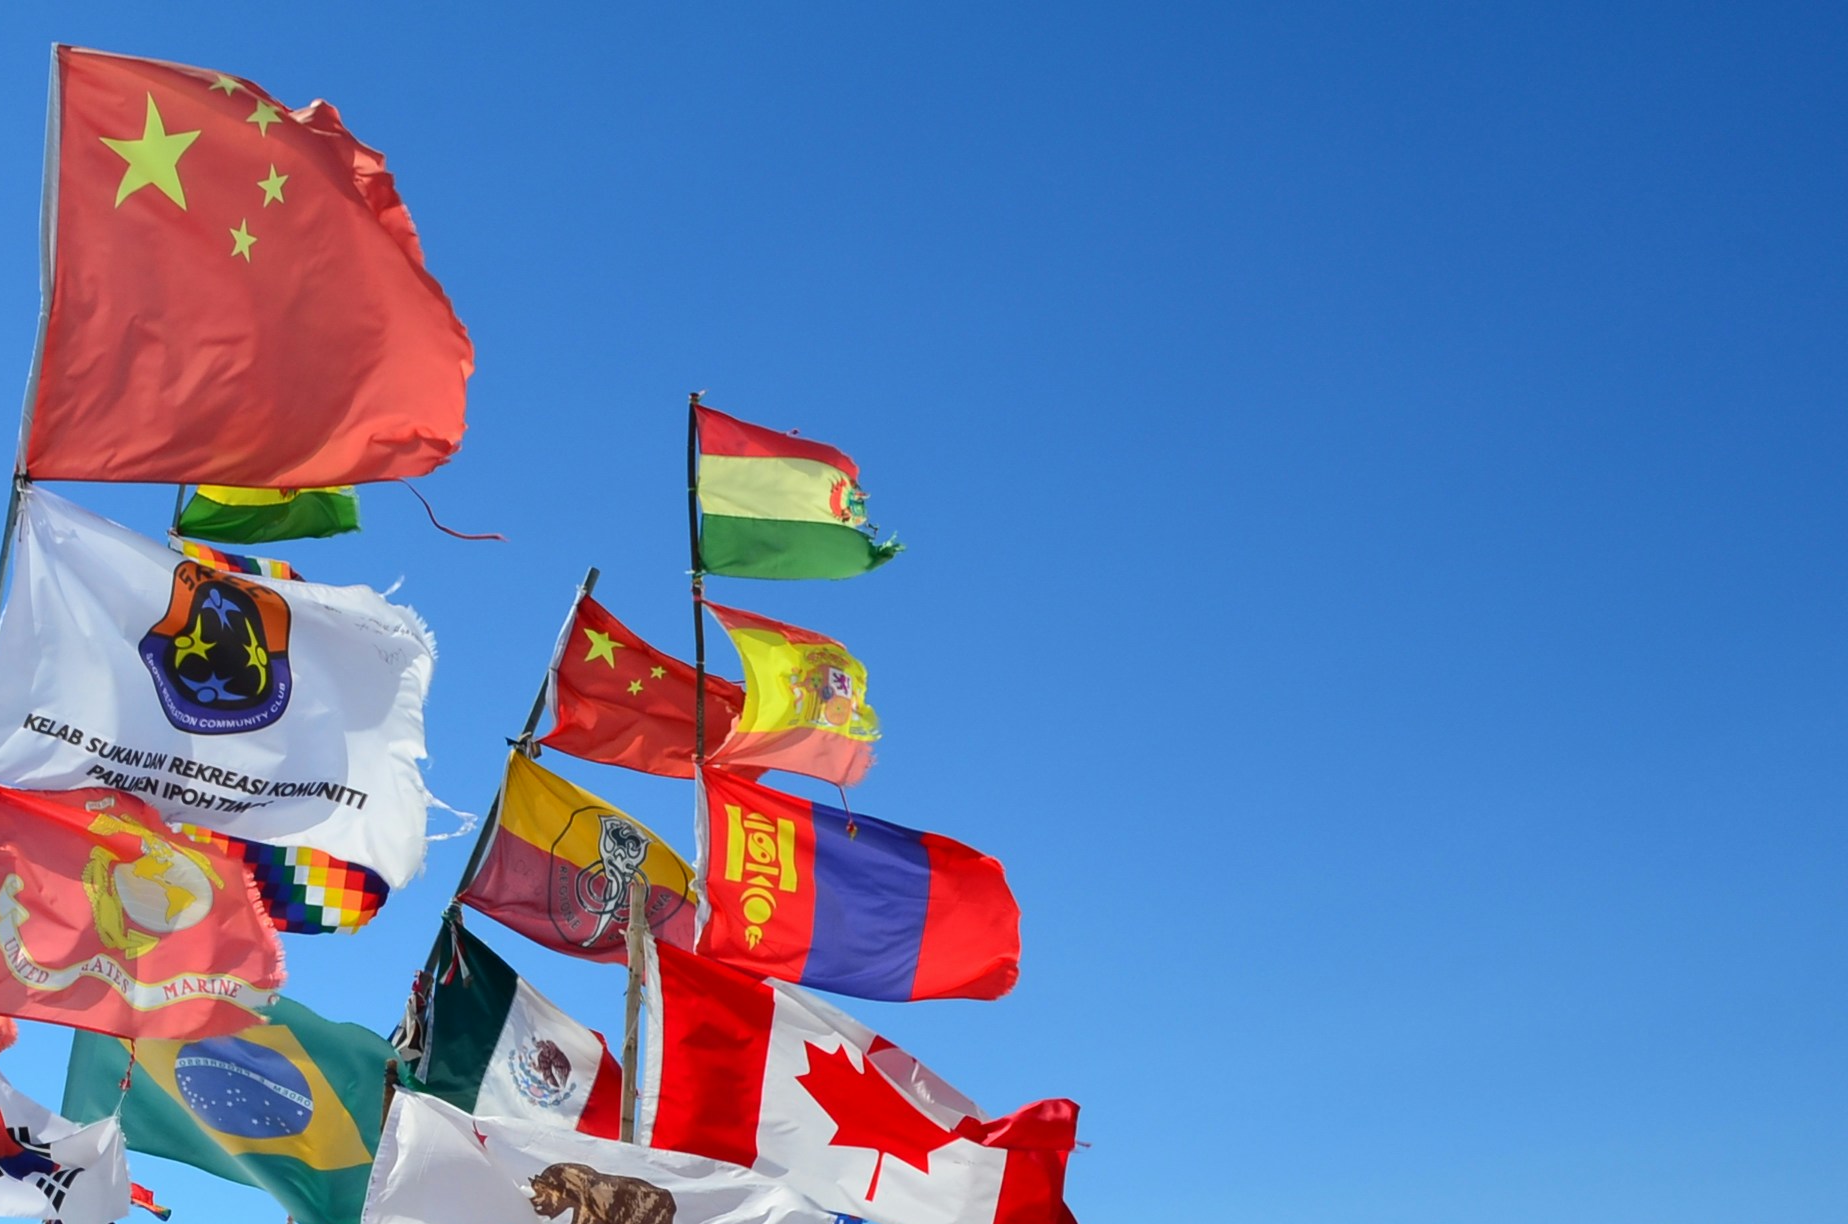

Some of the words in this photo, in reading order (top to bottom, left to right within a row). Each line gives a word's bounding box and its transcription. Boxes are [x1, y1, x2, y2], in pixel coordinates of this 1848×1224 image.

[199, 712, 269, 729] COMMUNITY
[271, 682, 286, 713] CLUB
[22, 713, 84, 746] KELAB
[85, 737, 144, 767] SUKAN
[142, 752, 168, 770] DAN
[168, 756, 270, 796] REKREASI
[267, 781, 369, 810] KOMUNITI
[162, 782, 215, 810] IPOH
[559, 865, 581, 930] REGIONE
[4, 937, 50, 985] UNITED
[81, 957, 130, 994] ATES
[162, 978, 243, 1001] MARINE
